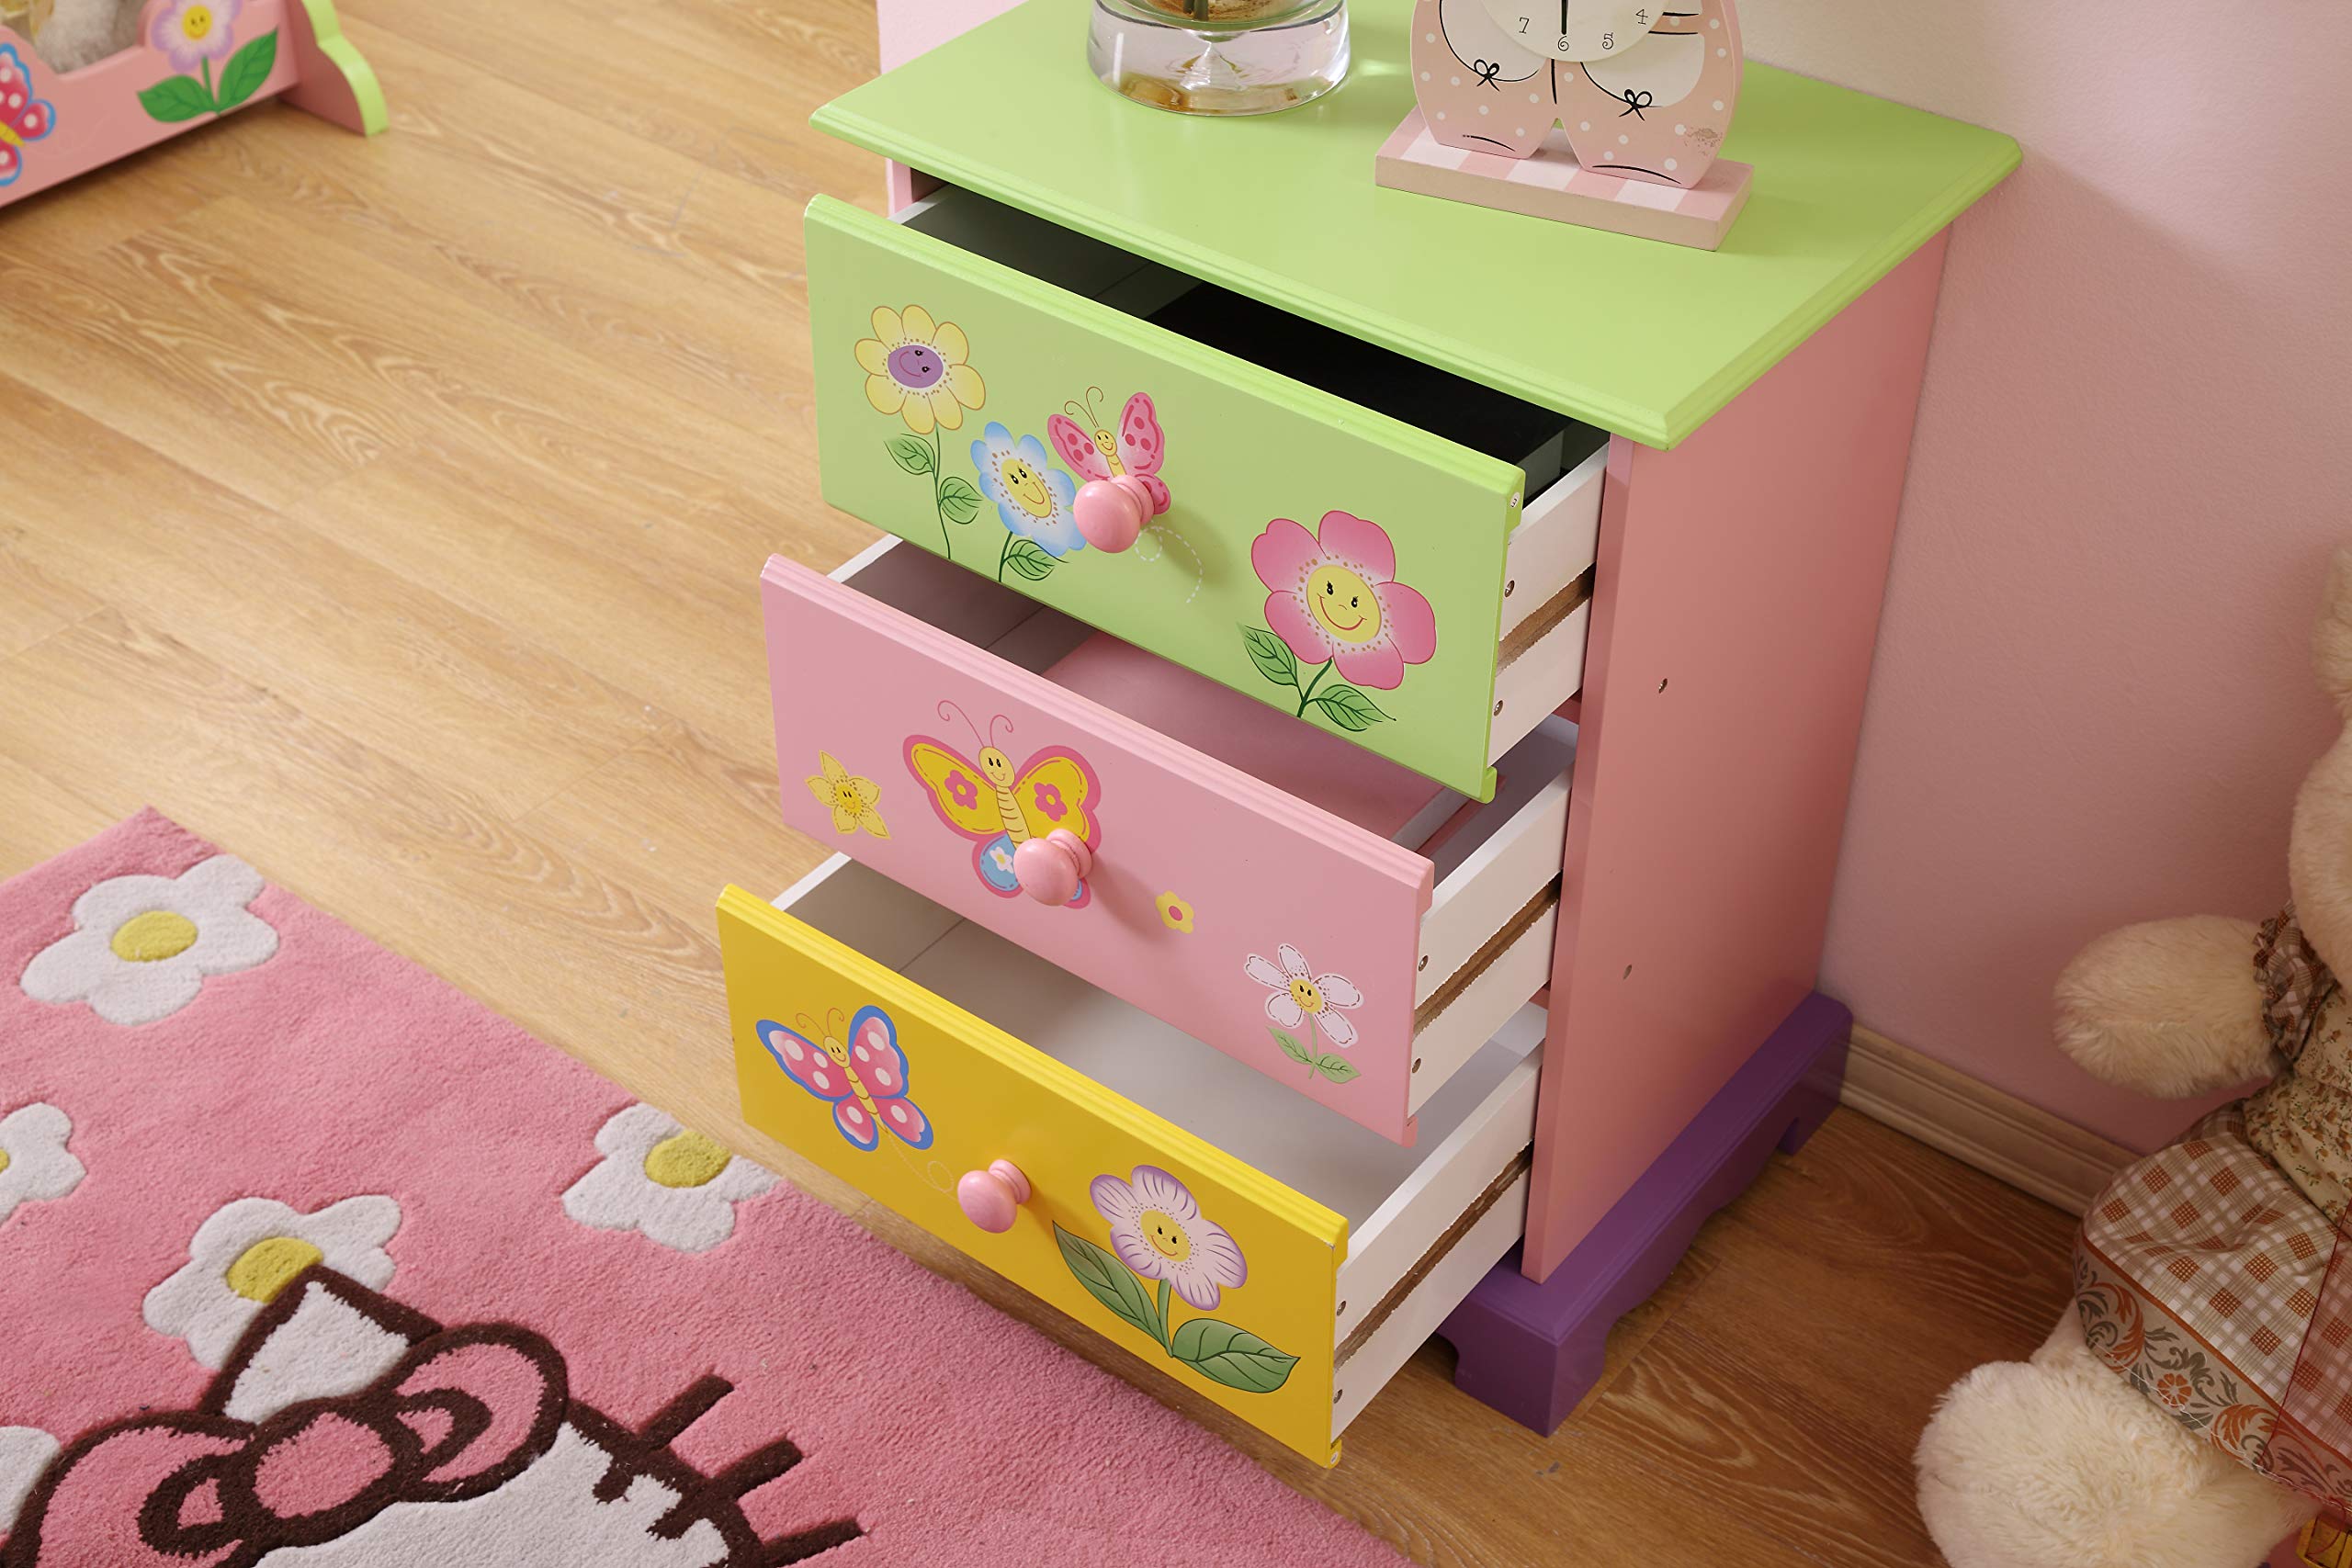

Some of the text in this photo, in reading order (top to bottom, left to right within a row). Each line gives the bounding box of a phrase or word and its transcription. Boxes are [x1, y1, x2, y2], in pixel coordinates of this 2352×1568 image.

[1635, 8, 1649, 25] 4
[1519, 17, 1530, 35] 7
[1557, 35, 1570, 51] 6
[1601, 32, 1614, 50] 5
